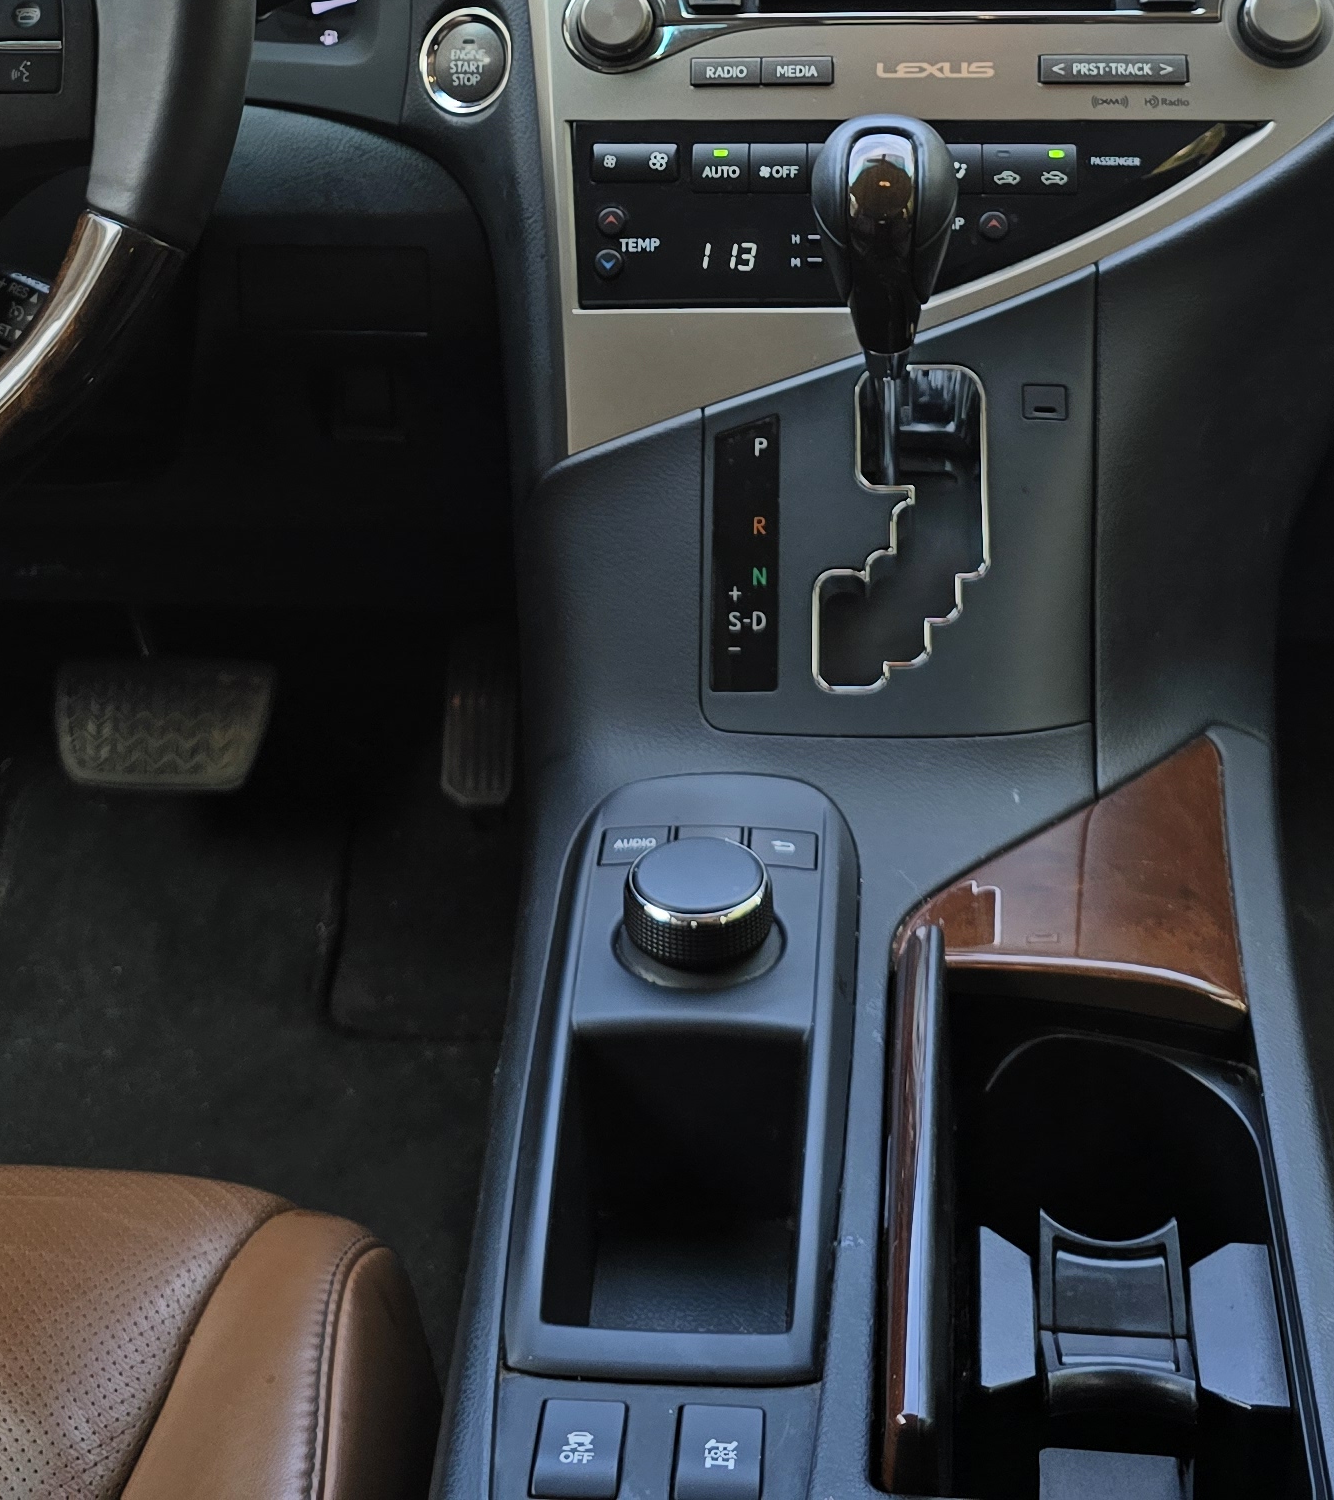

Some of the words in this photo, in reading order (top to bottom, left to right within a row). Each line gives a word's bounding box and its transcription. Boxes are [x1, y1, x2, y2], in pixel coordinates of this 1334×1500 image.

[449, 60, 485, 74] START
[705, 65, 748, 79] RADIO
[775, 65, 819, 79] MEDIA
[877, 61, 995, 79] LEXUS
[452, 74, 481, 87] STOP
[1090, 156, 1142, 167] PASSENGER
[701, 165, 741, 179] AUTO
[771, 165, 799, 179] OFF
[619, 237, 661, 253] TEMP
[753, 437, 768, 457] P
[752, 516, 767, 536] R
[751, 567, 767, 587] N
[612, 837, 657, 852] AUDIO
[559, 1450, 595, 1465] OFF
[704, 1448, 738, 1462] LOCK
